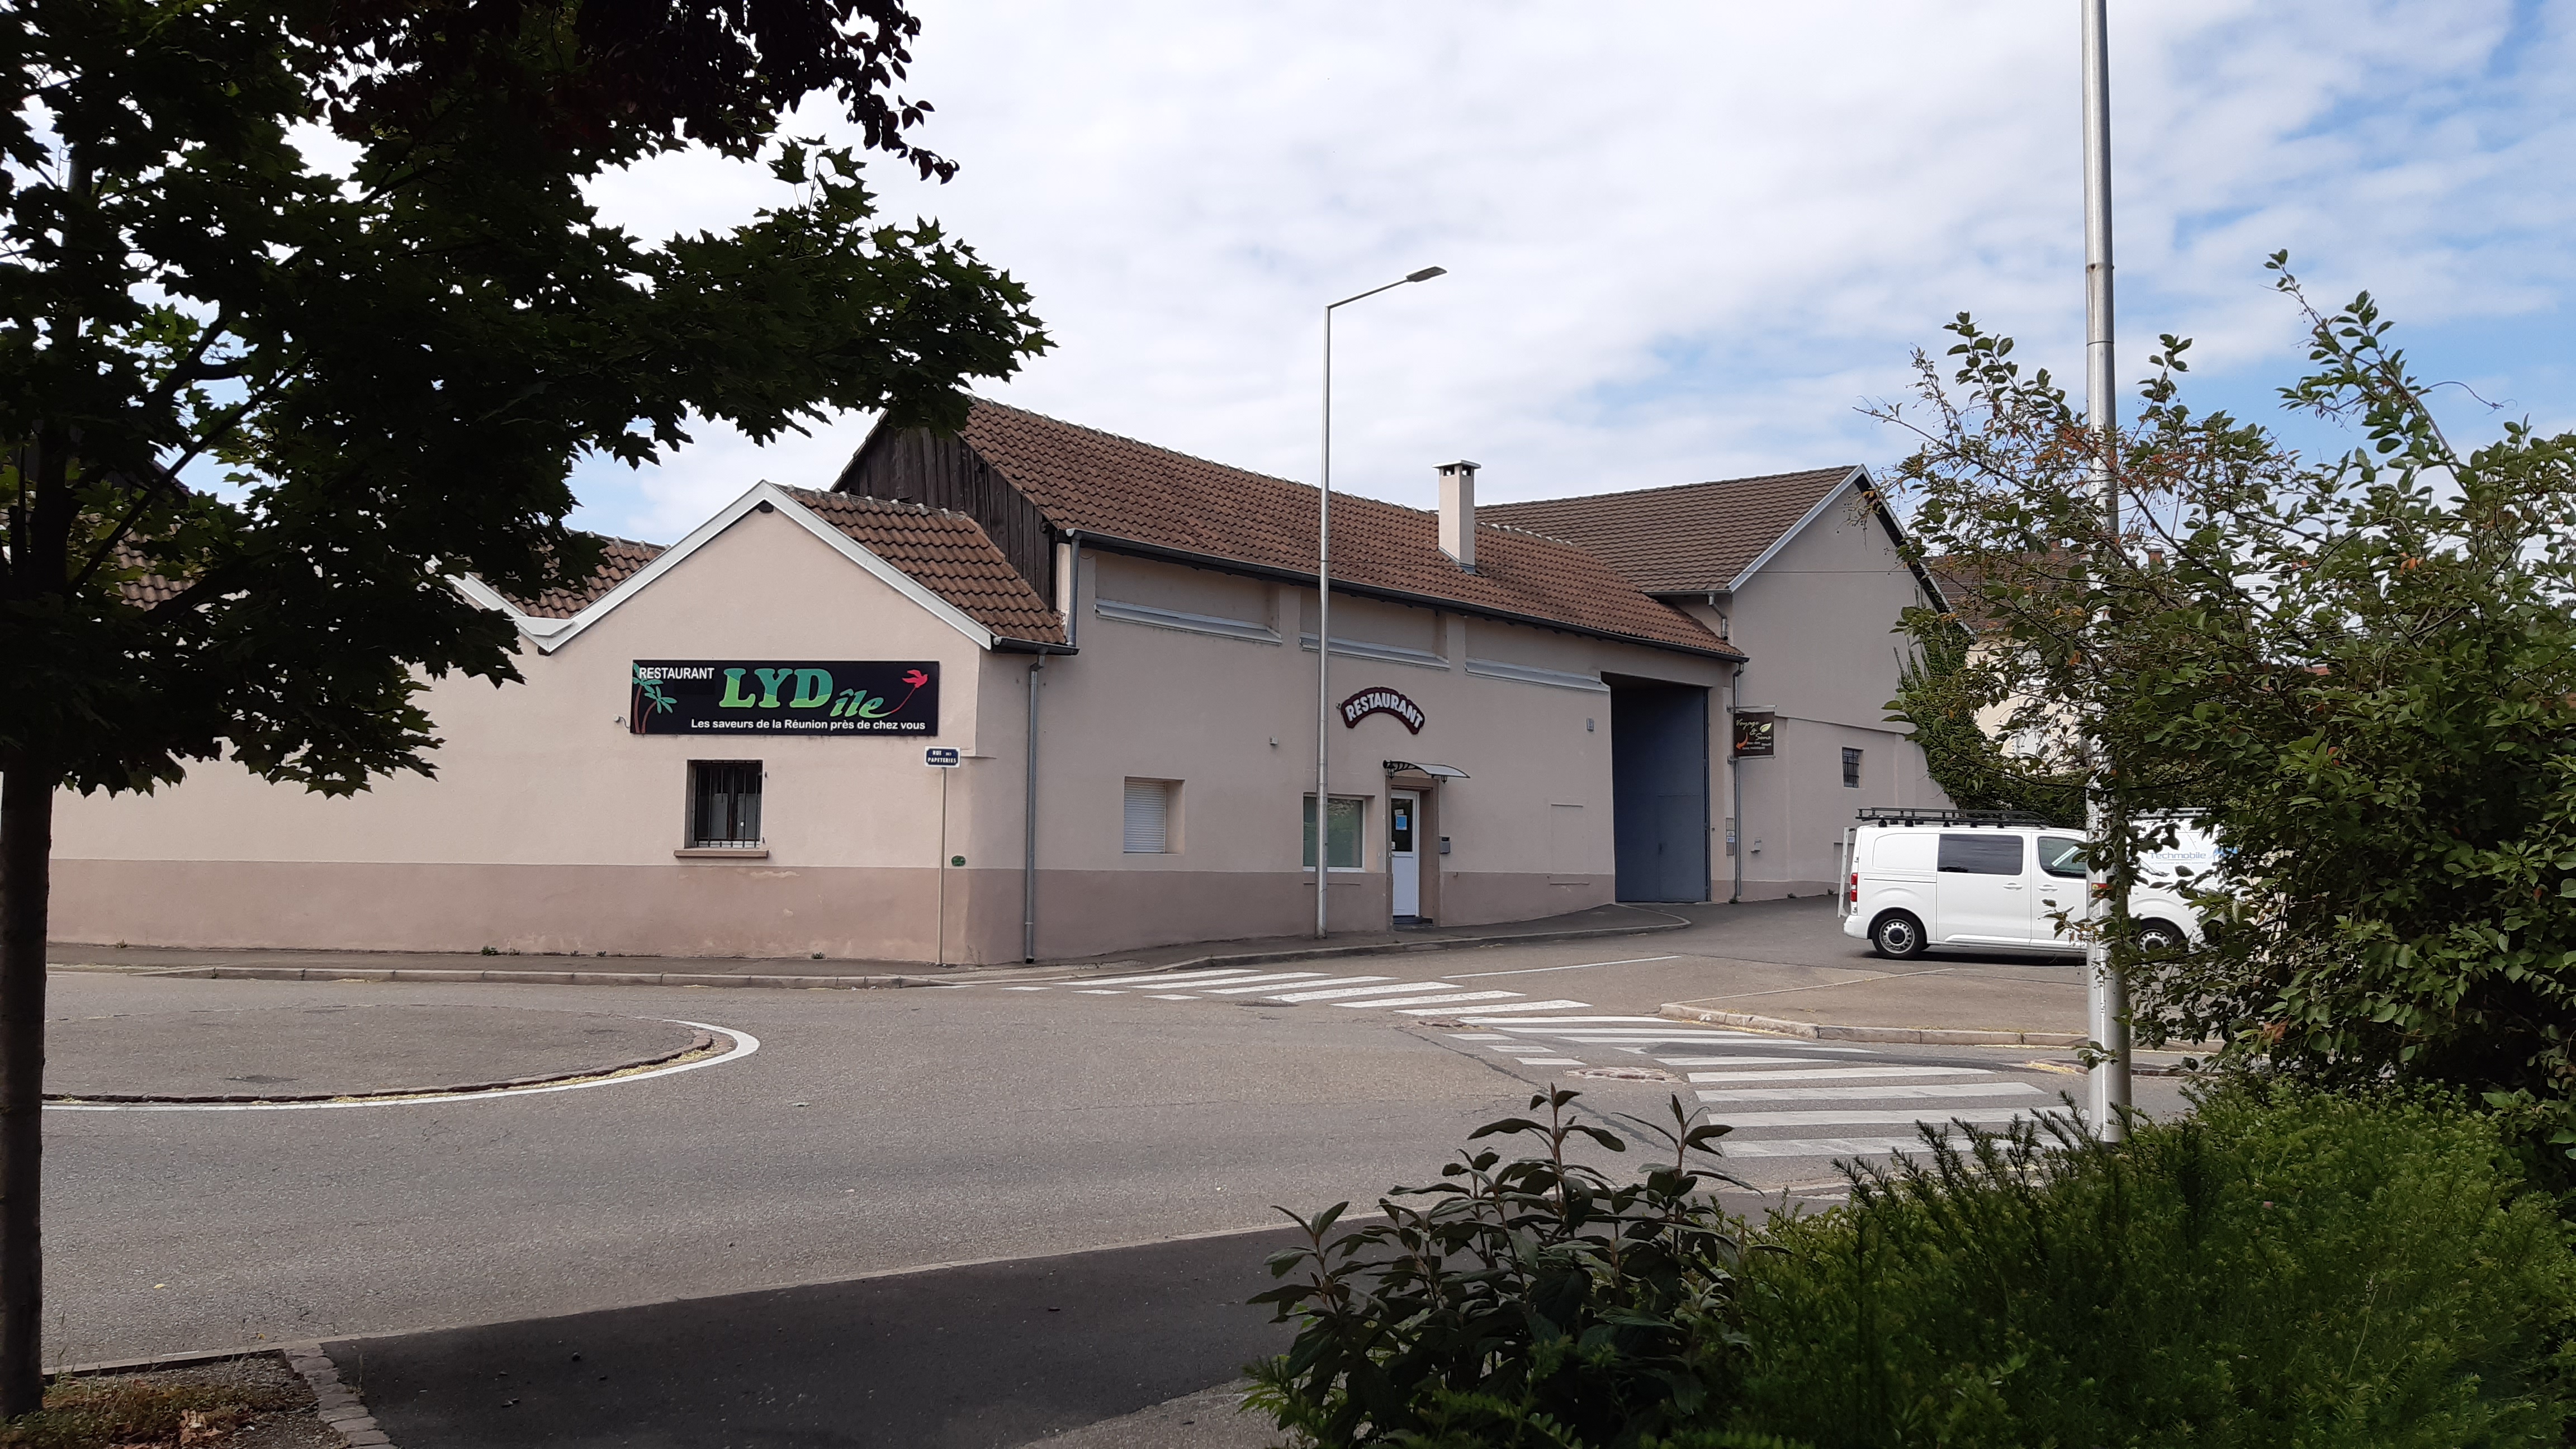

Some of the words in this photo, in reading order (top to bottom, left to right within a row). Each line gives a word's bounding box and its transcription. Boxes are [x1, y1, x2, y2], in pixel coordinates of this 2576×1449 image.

[639, 667, 715, 680] RESTAURANT
[718, 667, 834, 708] LYD
[830, 688, 891, 718] île
[1344, 692, 1423, 728] RESTAURANT
[691, 719, 710, 728] Les
[756, 719, 770, 728] de
[772, 719, 782, 728] la
[784, 719, 828, 729] Réunion
[830, 720, 855, 731] près
[857, 720, 870, 729] de
[873, 720, 898, 730] chez
[1736, 718, 1759, 730] Voyage
